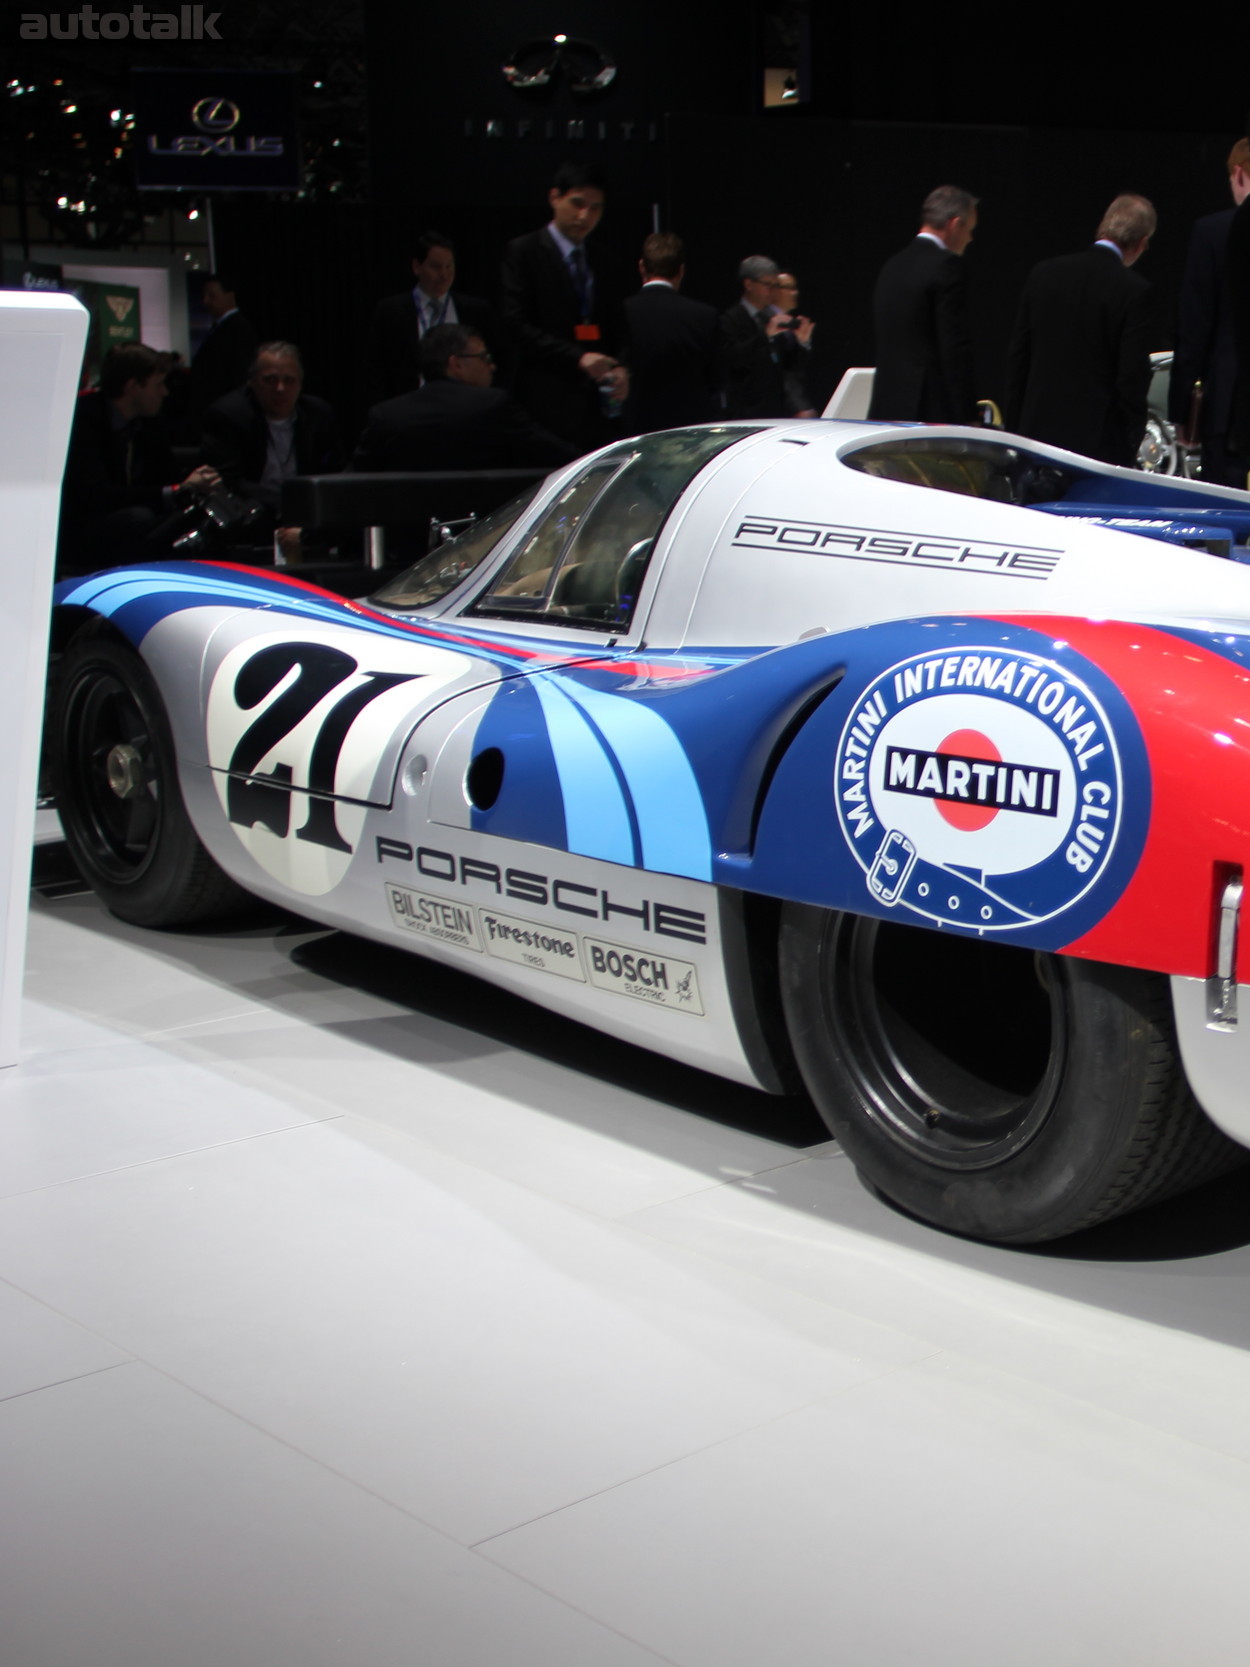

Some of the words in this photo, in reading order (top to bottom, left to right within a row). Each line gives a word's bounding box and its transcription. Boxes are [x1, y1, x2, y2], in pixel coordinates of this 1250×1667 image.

[146, 133, 285, 157] LEXUS
[463, 118, 659, 144] INFINITI
[734, 522, 1061, 573] PORSCHE
[227, 641, 430, 854] 21
[842, 690, 888, 838] MARTINI
[893, 655, 1105, 772] INTERNATIONAL
[1065, 780, 1111, 874] CLUB
[888, 751, 1054, 810] MARTINI
[376, 835, 706, 945] PORSCHE
[392, 889, 473, 936] BILSTEIN
[484, 915, 576, 958] Firestone
[591, 945, 669, 990] BOSCH
